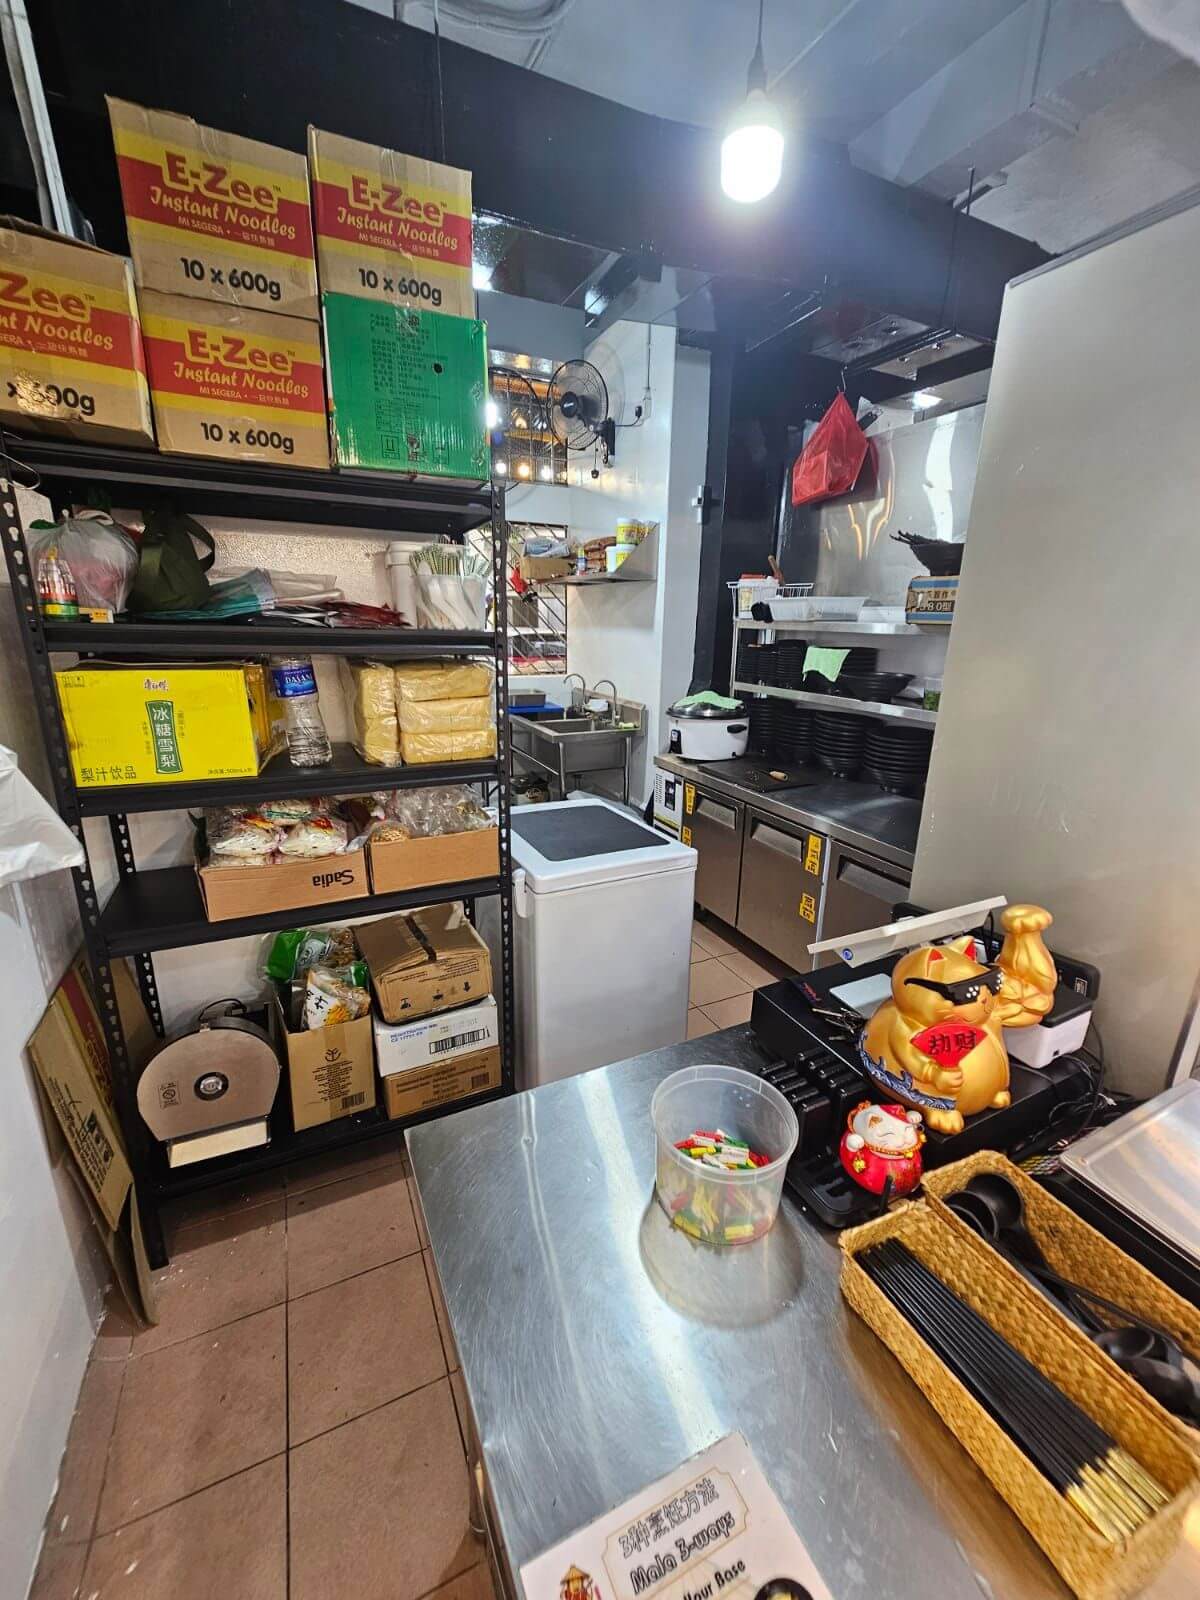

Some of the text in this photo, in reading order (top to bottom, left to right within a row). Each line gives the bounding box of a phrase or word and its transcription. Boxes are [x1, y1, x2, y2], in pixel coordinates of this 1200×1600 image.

[150, 186, 219, 221] Instant
[225, 206, 296, 240] Noodles
[337, 206, 394, 233] Instant
[398, 223, 458, 250] Noodles
[181, 257, 281, 300] 10 x 600g
[358, 268, 442, 306] 10 x 600g
[24, 315, 113, 350] Noodles
[173, 362, 309, 398] Instant Noodles
[211, 387, 242, 400] SEGERA
[201, 422, 294, 454] 10 x 600g
[152, 706, 177, 769] 冰糖雪梨
[80, 764, 137, 782] 梨汁饮品
[312, 869, 354, 888] Sadia
[618, 1477, 720, 1560] 3种烹饪方法
[630, 1511, 736, 1596] Mala 3-ways
[714, 1559, 746, 1590] Base
